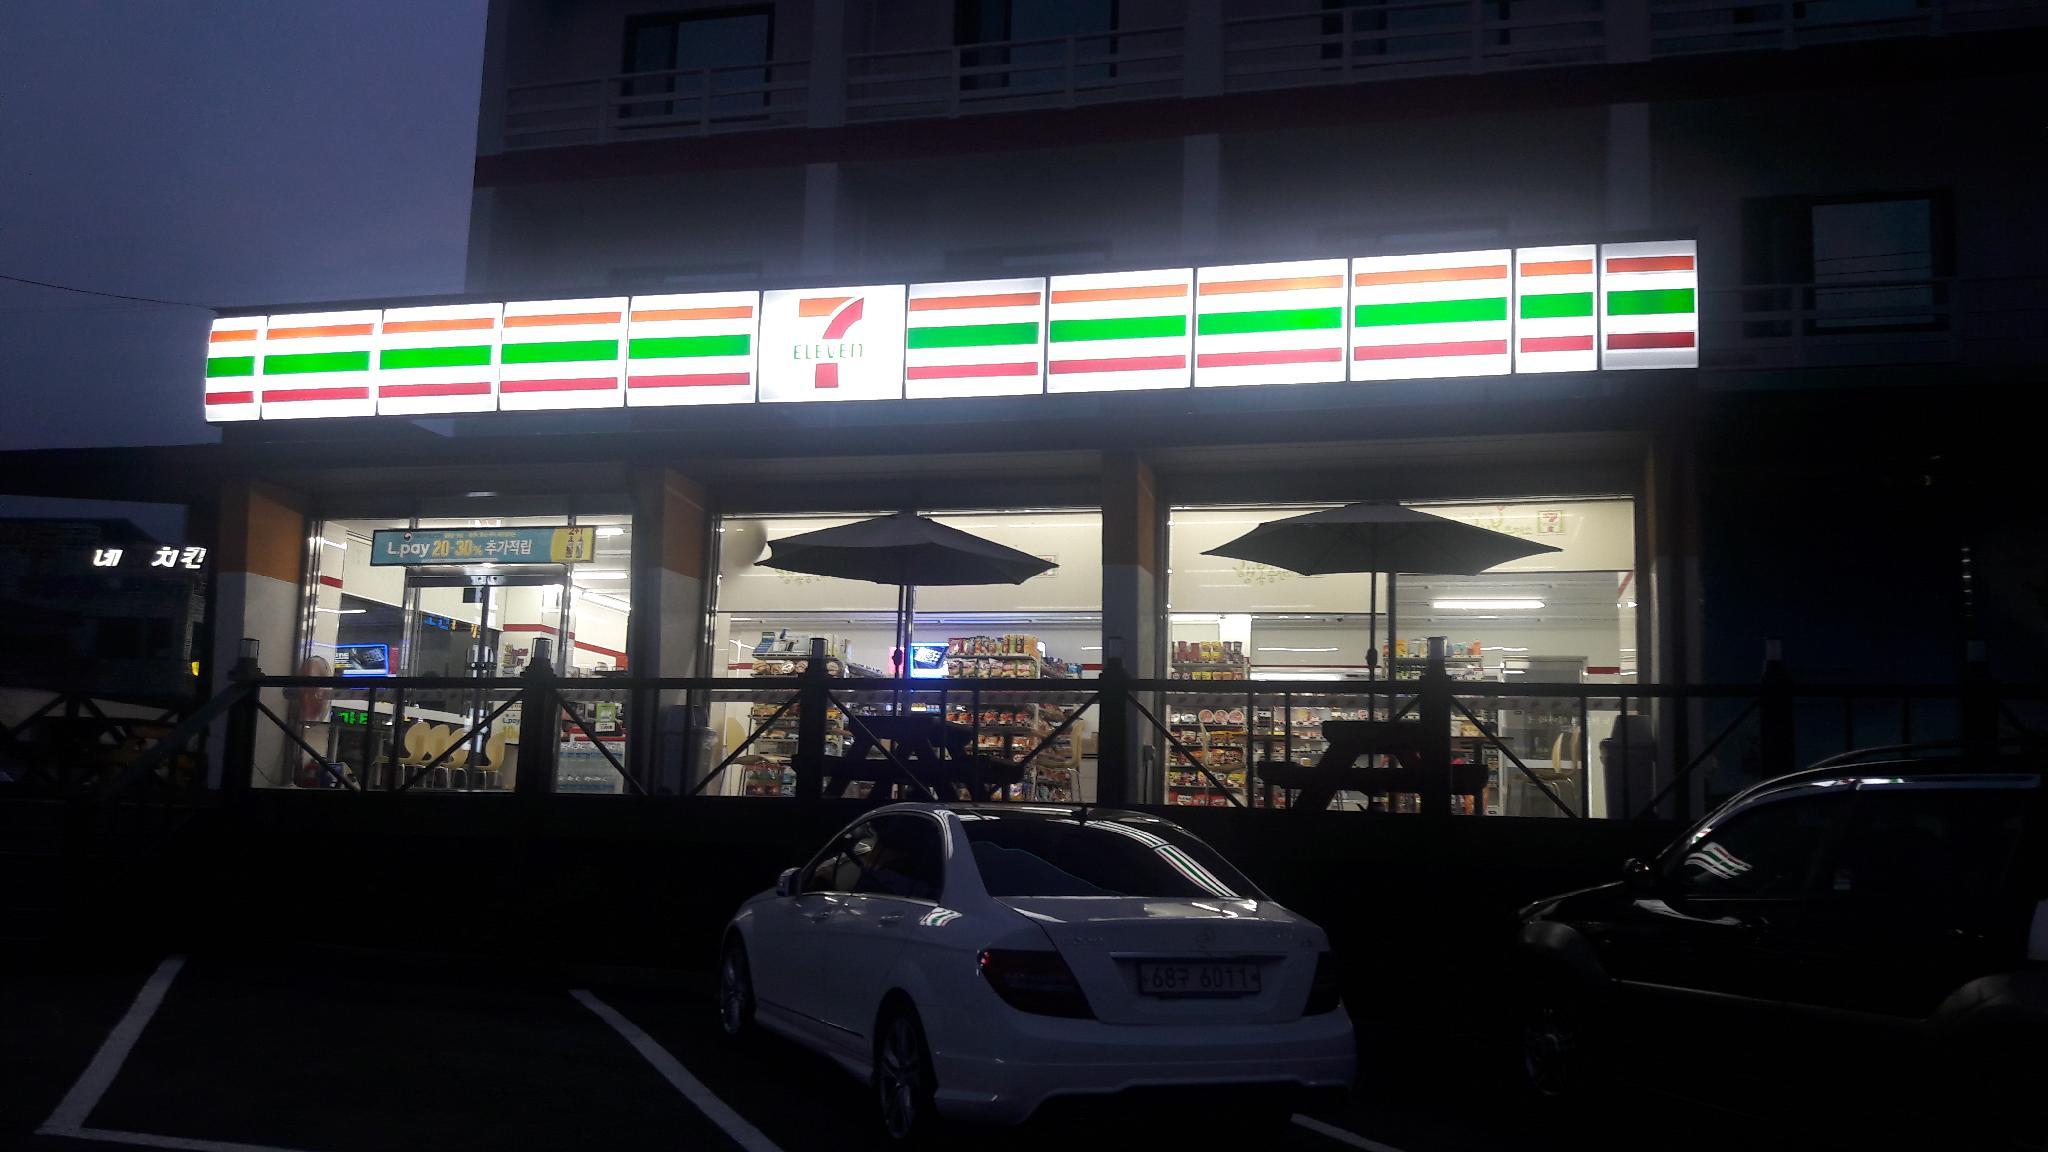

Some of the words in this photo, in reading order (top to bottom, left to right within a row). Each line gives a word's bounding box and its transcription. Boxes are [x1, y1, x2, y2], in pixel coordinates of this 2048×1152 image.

[798, 296, 864, 388] 7
[93, 548, 124, 567] 네
[151, 546, 207, 569] 치킨
[387, 541, 430, 558] L.pay
[485, 539, 531, 556] 추가적립
[1200, 967, 1248, 988] 6011
